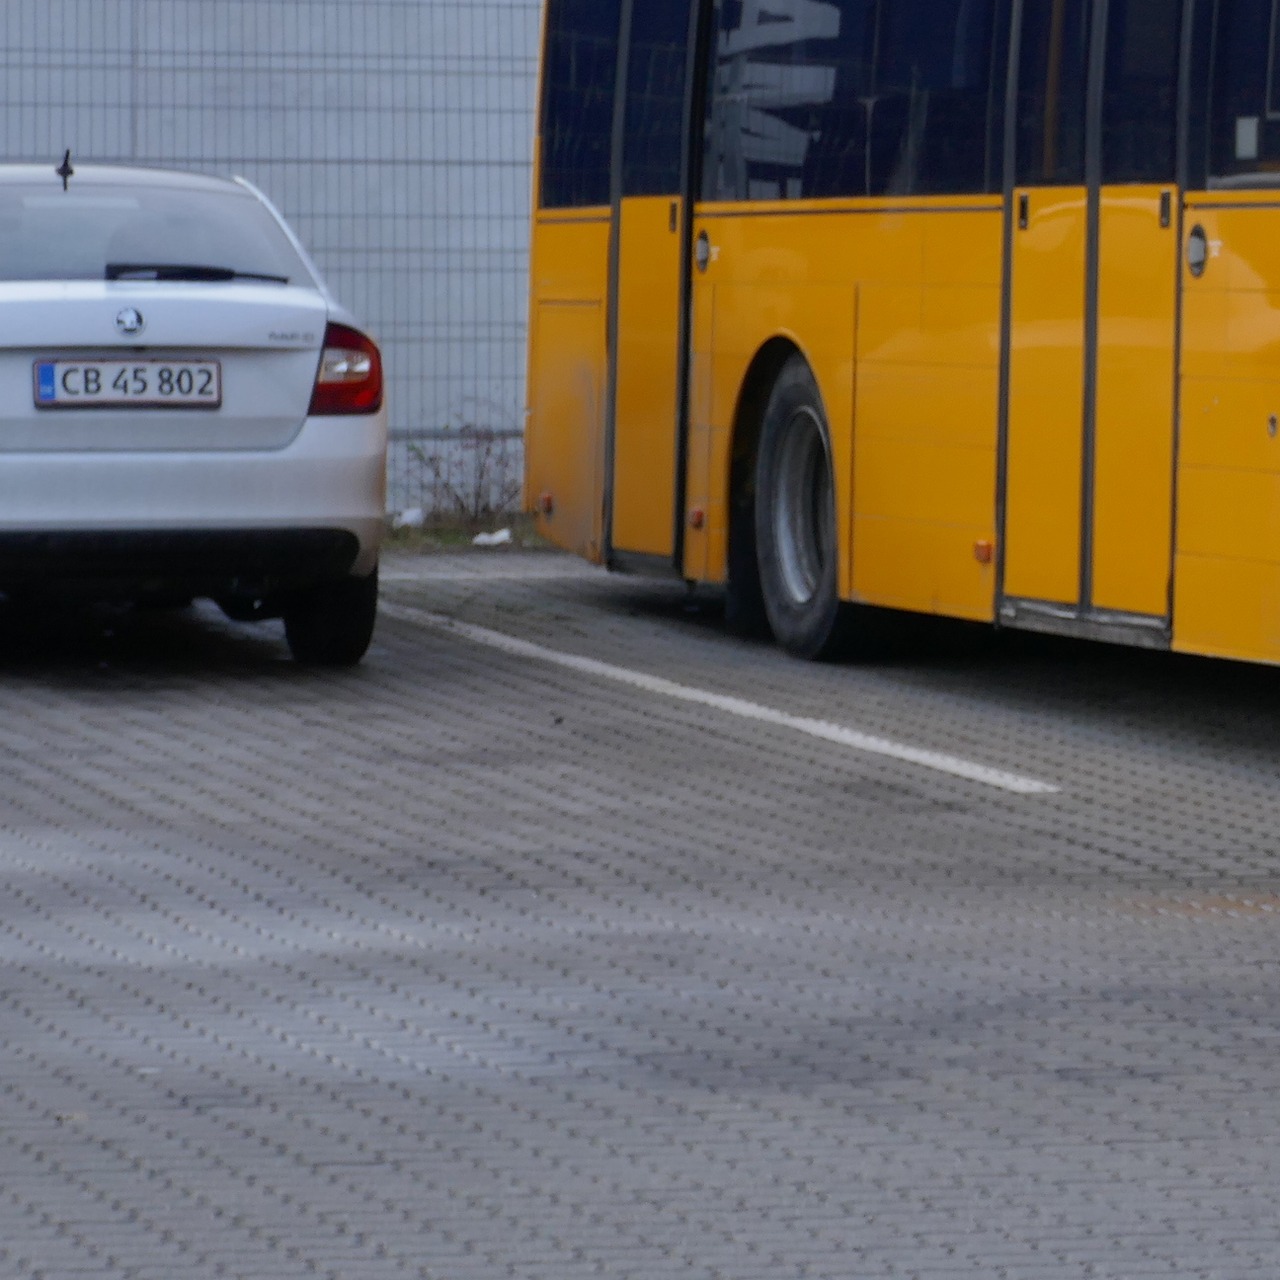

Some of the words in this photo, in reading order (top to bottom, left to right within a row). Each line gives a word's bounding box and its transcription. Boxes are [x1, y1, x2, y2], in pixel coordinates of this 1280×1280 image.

[61, 367, 102, 396] CB
[111, 367, 148, 396] 45
[157, 367, 214, 396] 802
